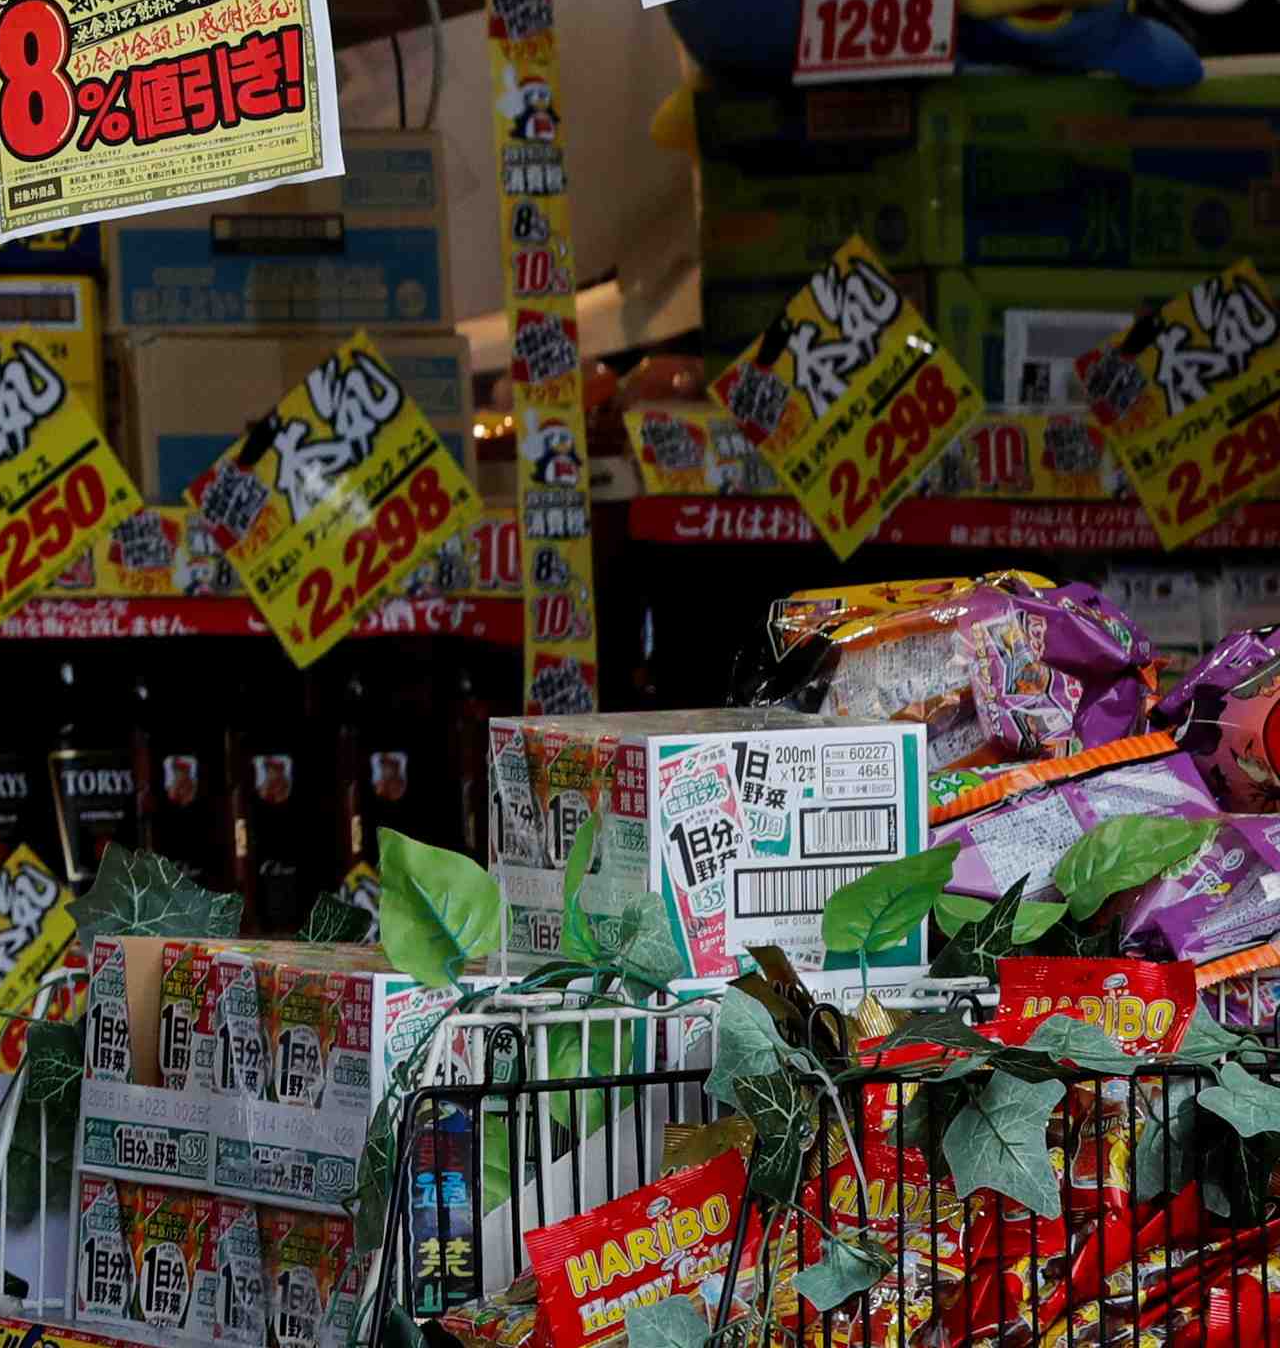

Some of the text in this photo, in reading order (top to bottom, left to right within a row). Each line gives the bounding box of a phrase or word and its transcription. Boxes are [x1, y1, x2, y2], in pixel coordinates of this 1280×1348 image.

[775, 744, 816, 764] 200ml
[849, 743, 889, 760] 60227
[857, 763, 890, 778] 4645
[62, 767, 134, 796] TORYS
[566, 1192, 731, 1298] HARIBO
